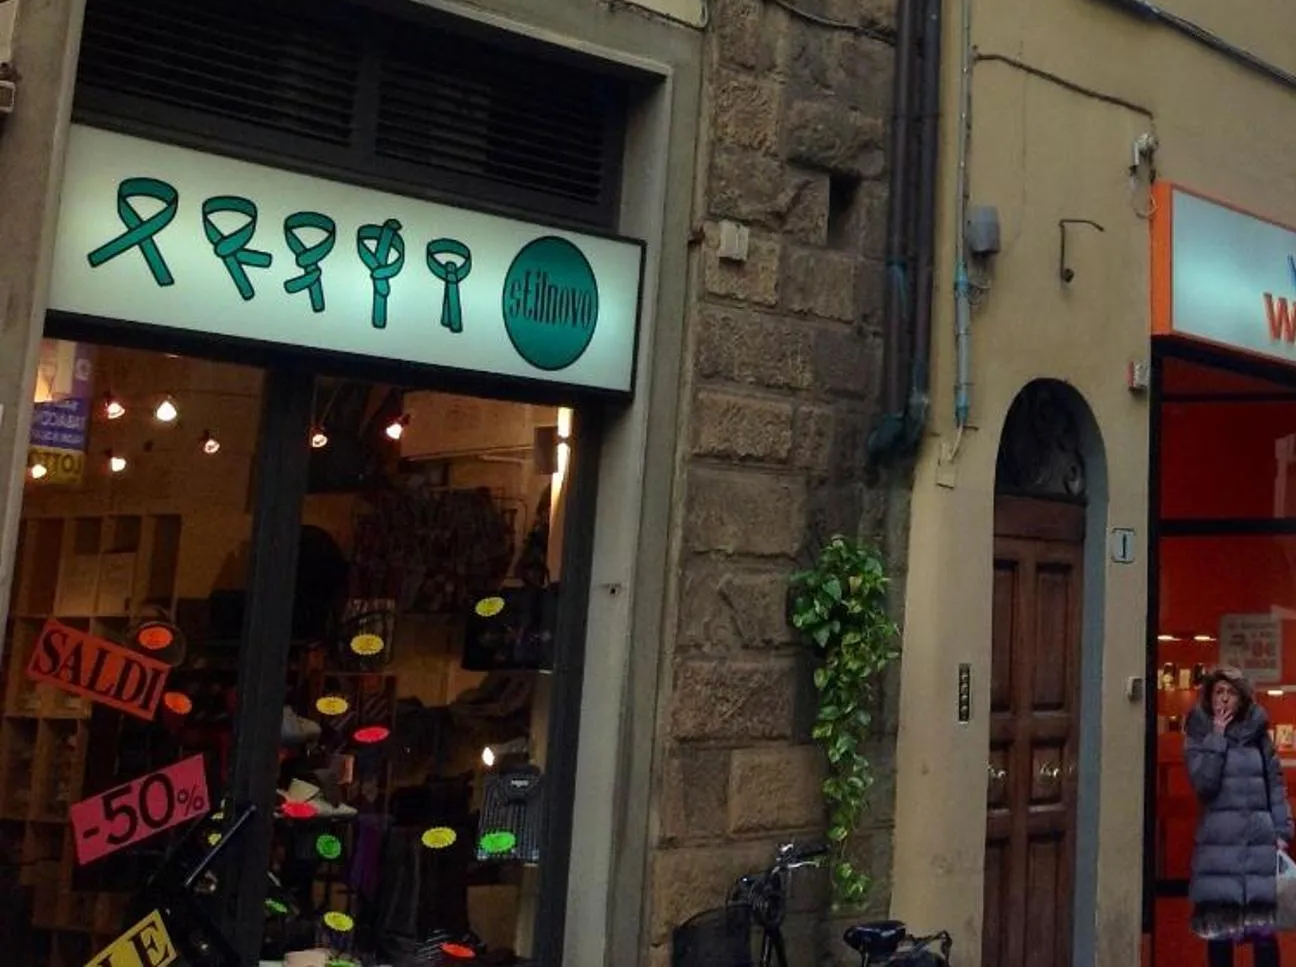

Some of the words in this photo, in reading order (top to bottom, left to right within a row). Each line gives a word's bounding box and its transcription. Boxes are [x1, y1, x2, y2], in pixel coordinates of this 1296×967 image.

[509, 269, 593, 329] stilnovo
[32, 629, 167, 711] SALDI
[83, 772, 205, 846] -50%
